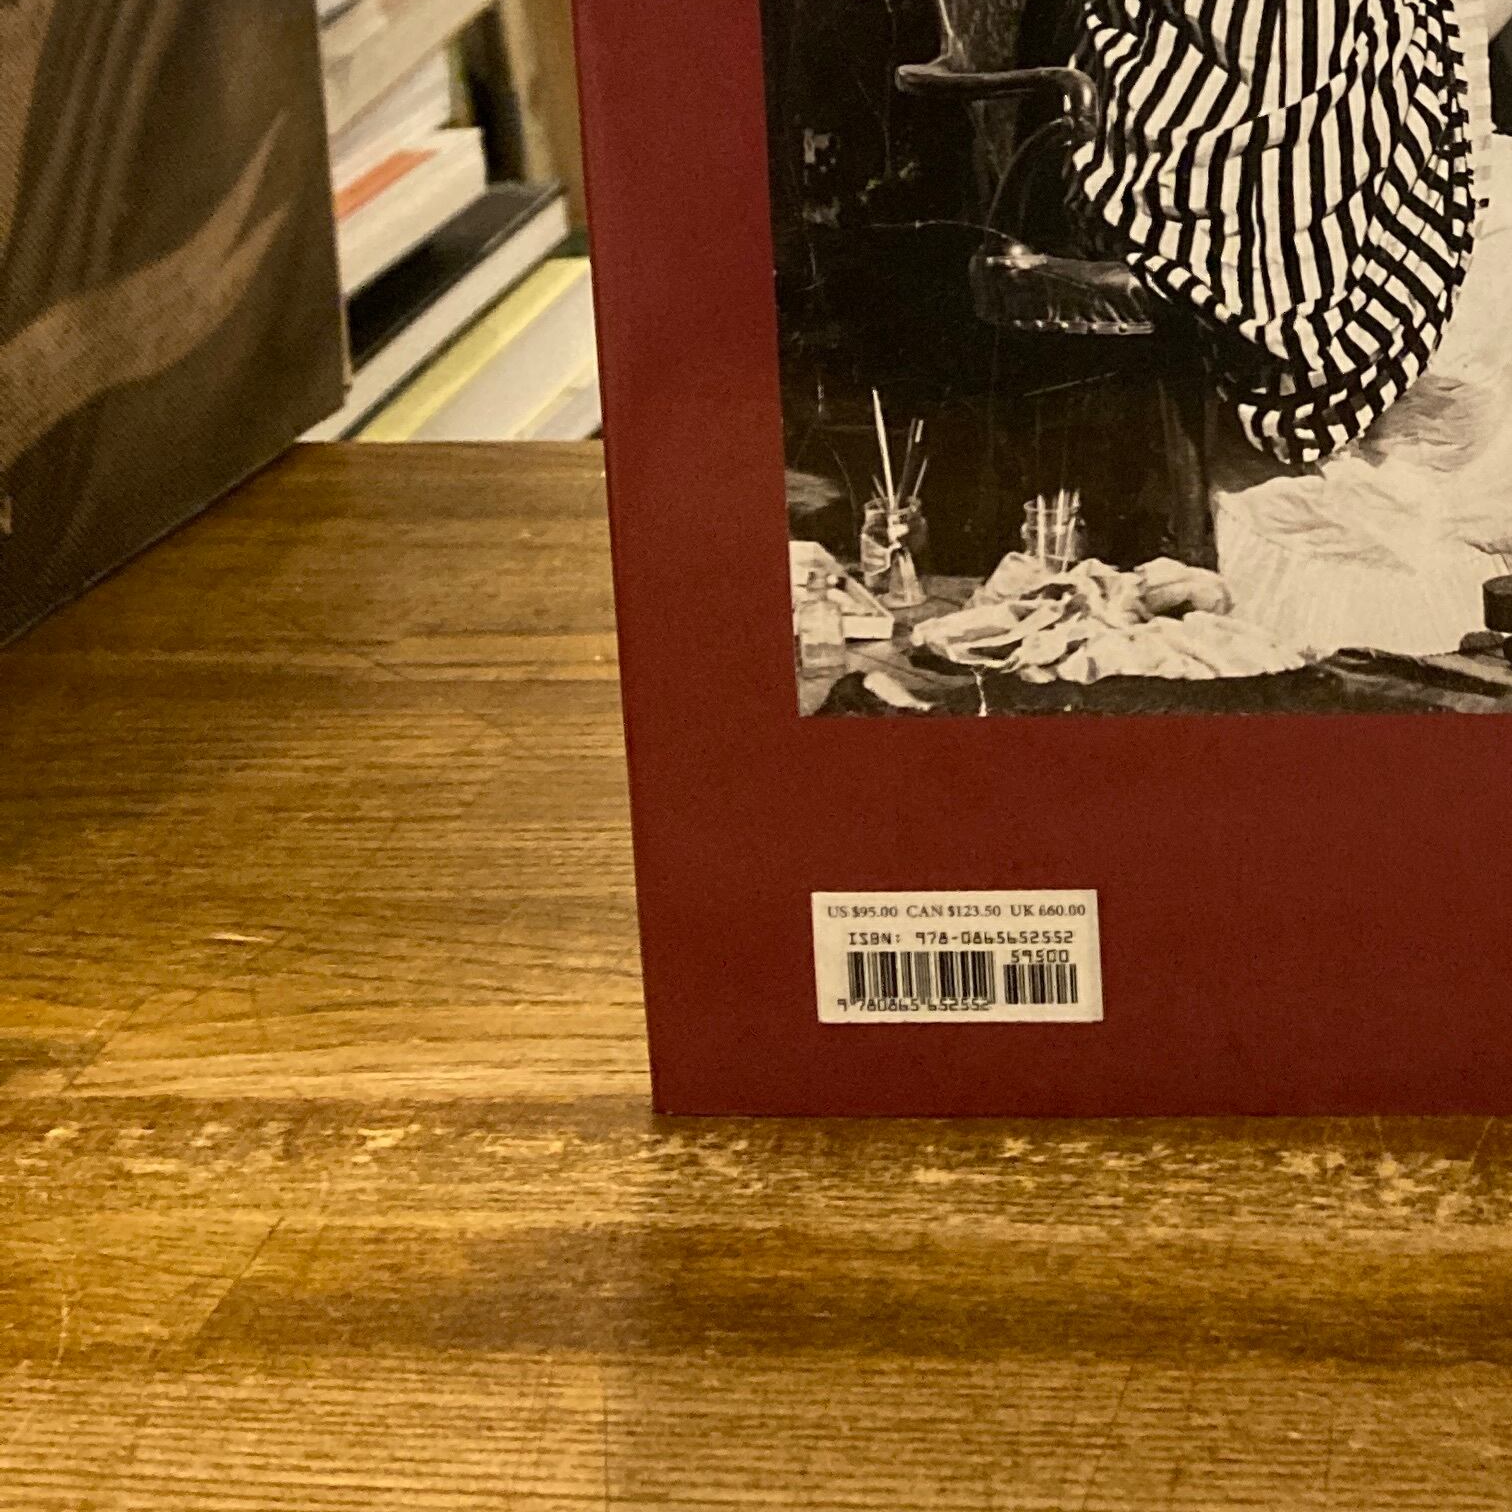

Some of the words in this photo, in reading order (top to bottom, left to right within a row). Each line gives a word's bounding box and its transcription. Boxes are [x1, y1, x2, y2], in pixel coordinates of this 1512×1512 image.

[827, 905, 848, 918] US
[851, 904, 898, 918] $95.00
[906, 905, 943, 918] CAN
[947, 904, 1001, 918] $123.50
[1010, 904, 1034, 917] UK
[1011, 949, 1070, 963] 59500
